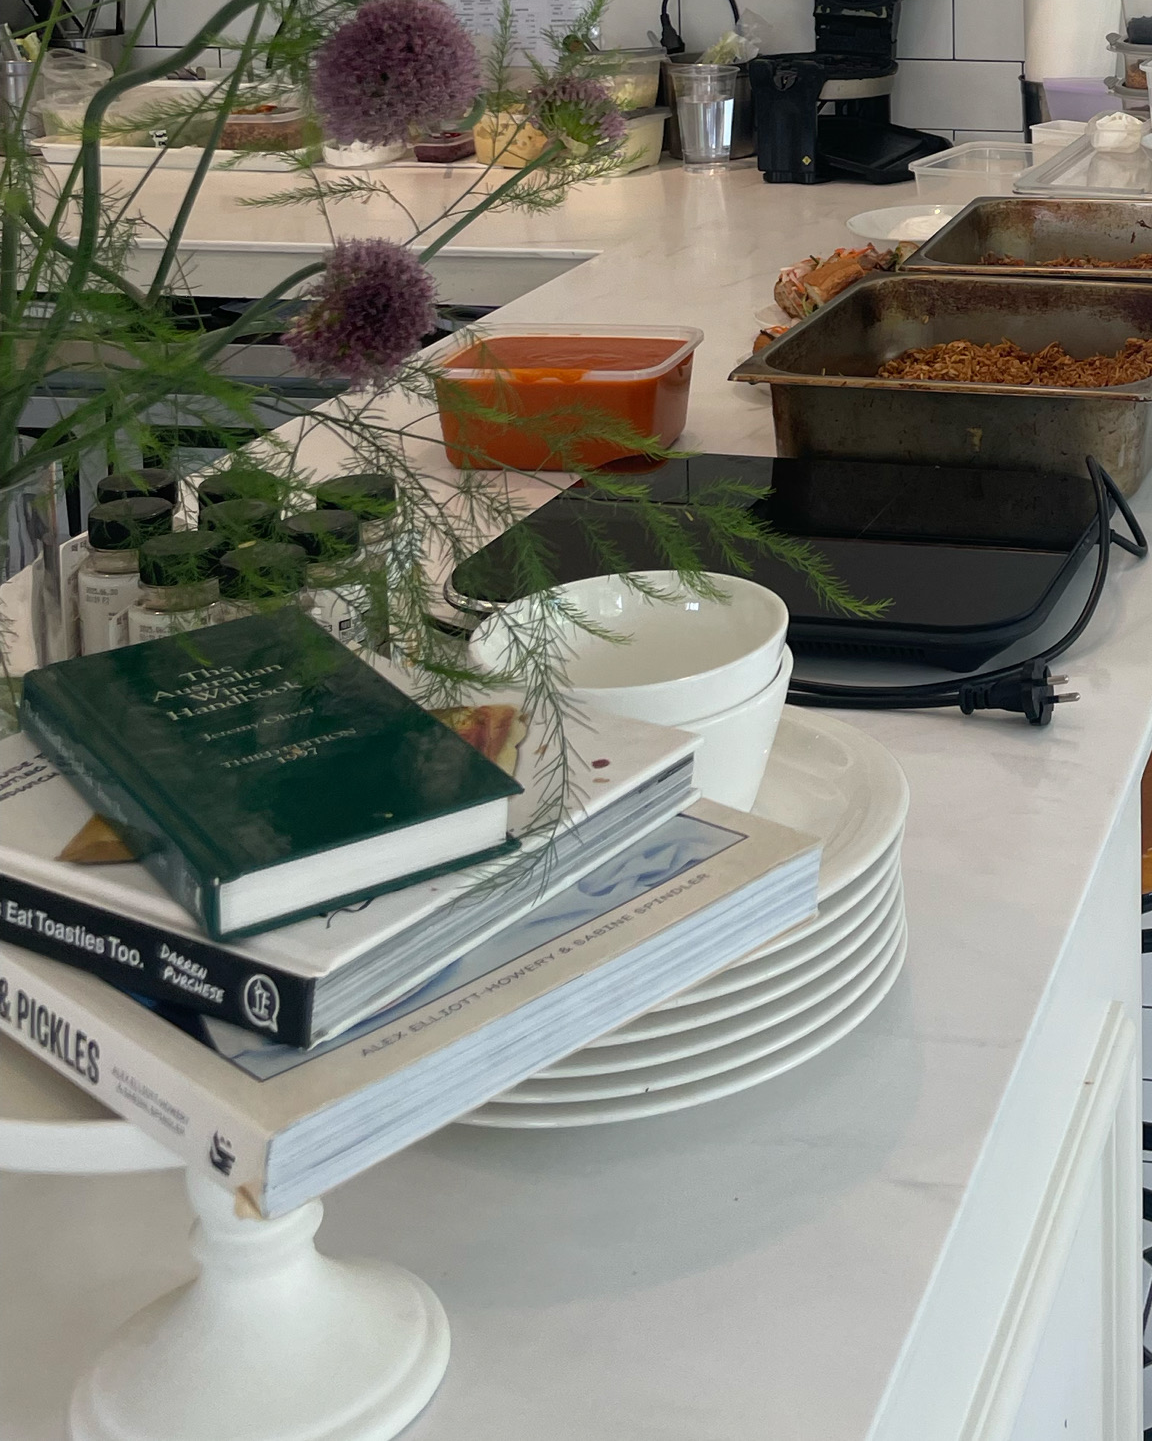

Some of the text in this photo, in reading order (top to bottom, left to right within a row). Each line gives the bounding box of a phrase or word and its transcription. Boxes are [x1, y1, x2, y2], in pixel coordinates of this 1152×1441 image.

[153, 663, 283, 703] Australian
[179, 665, 234, 682] The
[190, 679, 262, 702] Wine
[166, 680, 303, 721] Handbook
[202, 723, 260, 742] Jeremy
[4, 901, 145, 970] Eat Toasties Too.
[159, 943, 209, 981] DARREN
[360, 1029, 408, 1058] ALEX
[407, 951, 557, 1034] ELLIOTT-HOWERY
[572, 912, 634, 947] SABINE
[633, 871, 711, 916] SPINDLER
[162, 964, 227, 1004] PURCHESE
[0, 976, 100, 1086] & PICKLES
